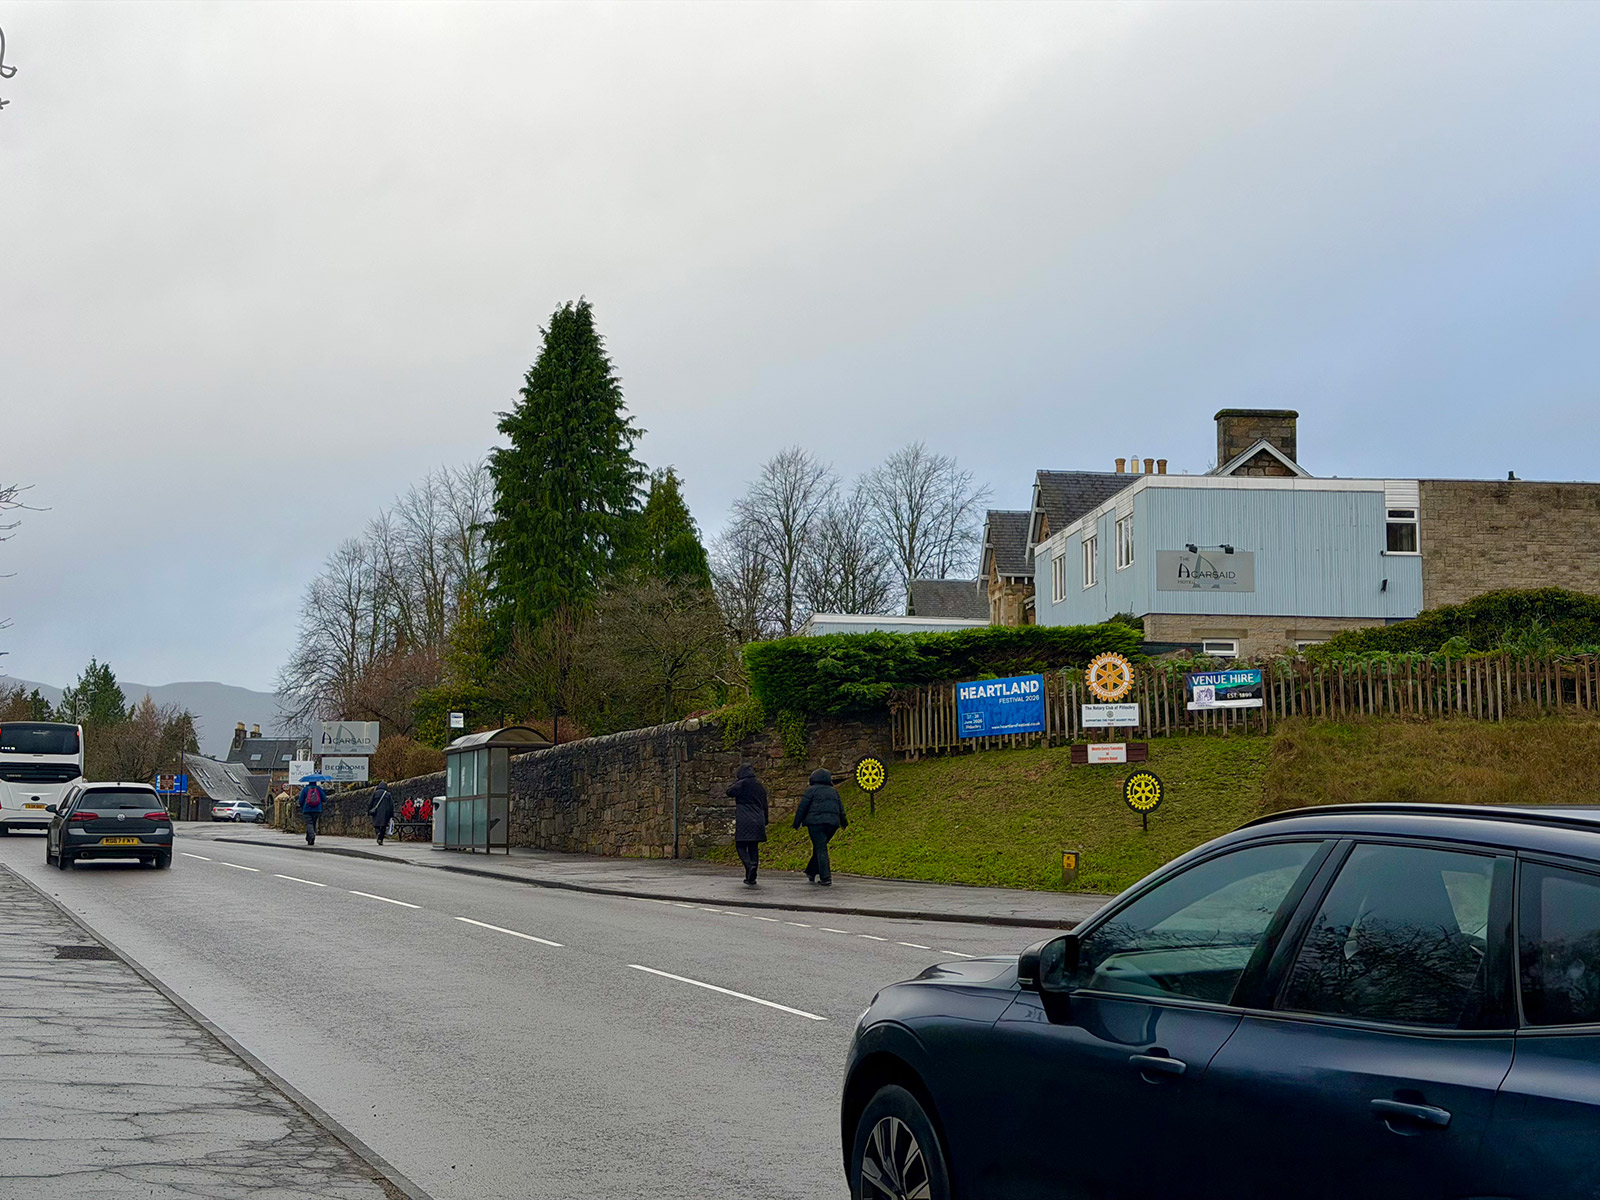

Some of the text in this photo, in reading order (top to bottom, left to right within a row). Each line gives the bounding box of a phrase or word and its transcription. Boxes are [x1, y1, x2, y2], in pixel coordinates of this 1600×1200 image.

[1178, 562, 1236, 579] ACARSAID
[1192, 673, 1254, 685] VENUE HIRE
[960, 680, 1040, 700] HEARTLAND
[1025, 694, 1040, 702] 2026
[321, 731, 371, 744] ACARSAID
